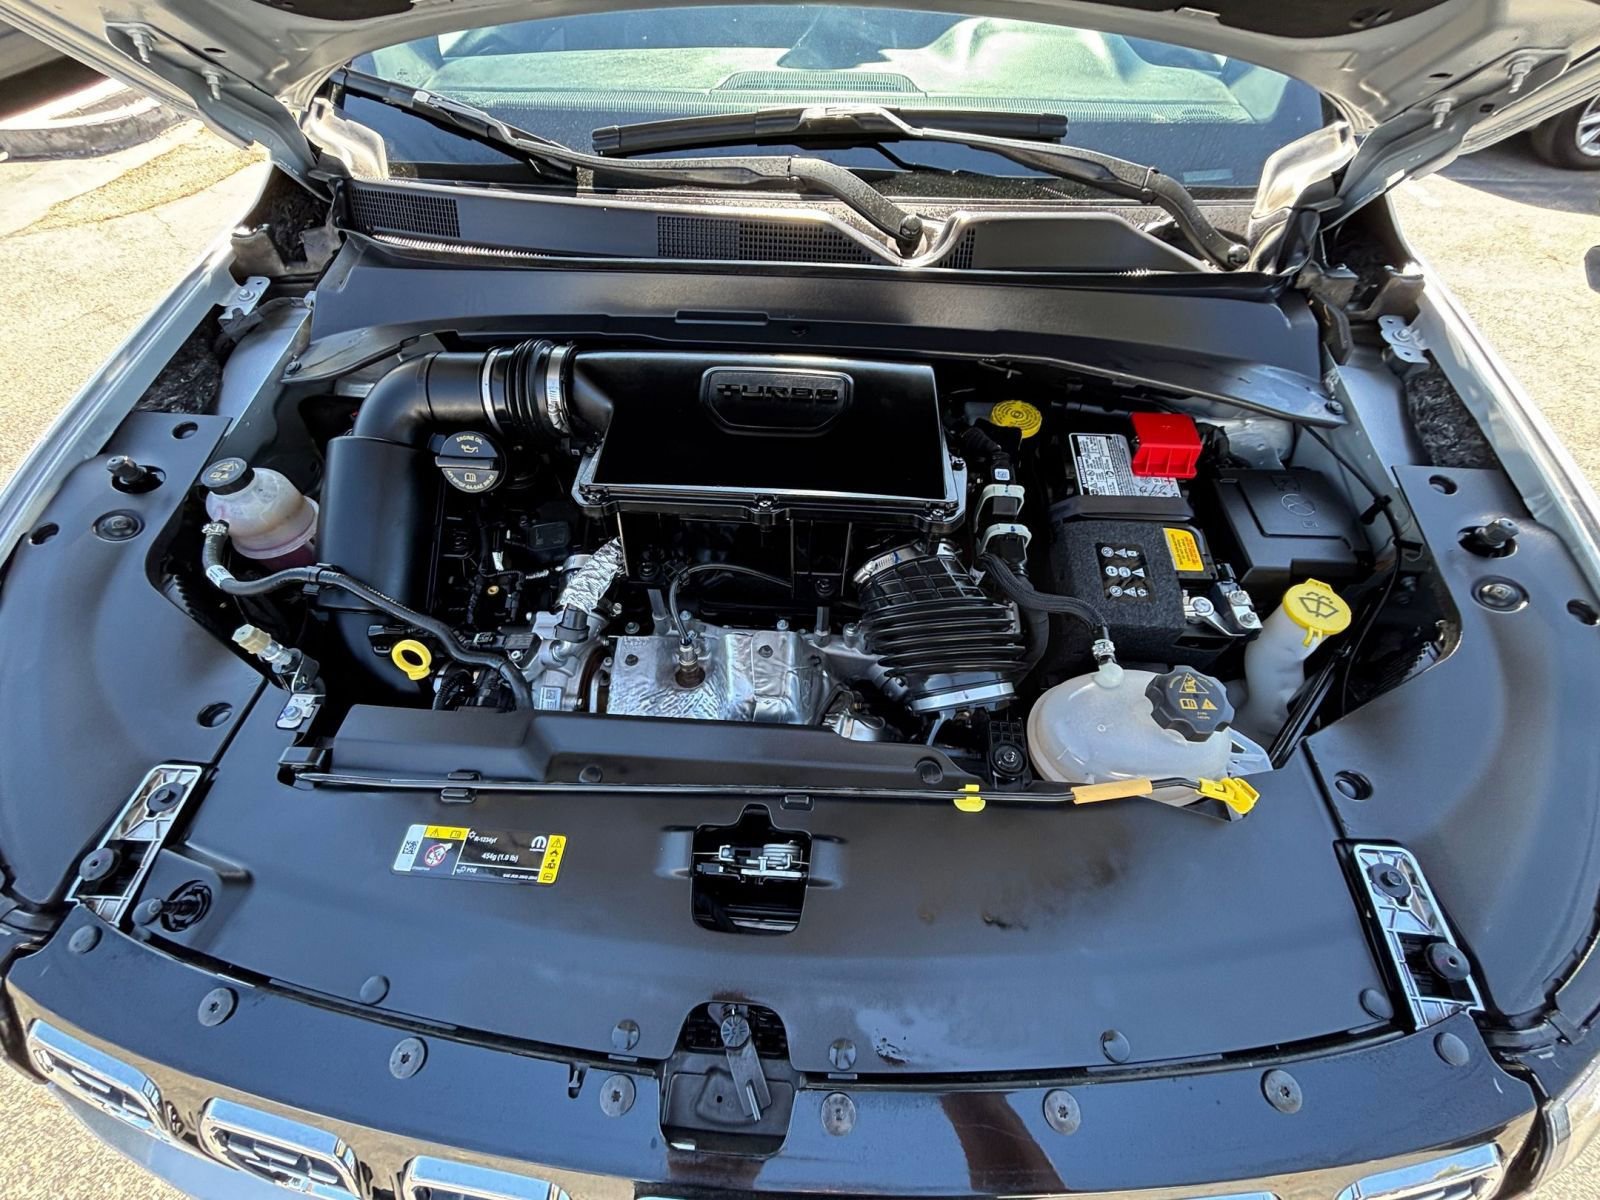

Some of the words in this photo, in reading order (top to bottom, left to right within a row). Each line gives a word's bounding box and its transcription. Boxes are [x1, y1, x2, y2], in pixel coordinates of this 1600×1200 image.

[716, 383, 839, 400] TURBO
[481, 852, 497, 862] 454g
[497, 852, 509, 862] (1.0
[510, 854, 519, 863] lb)
